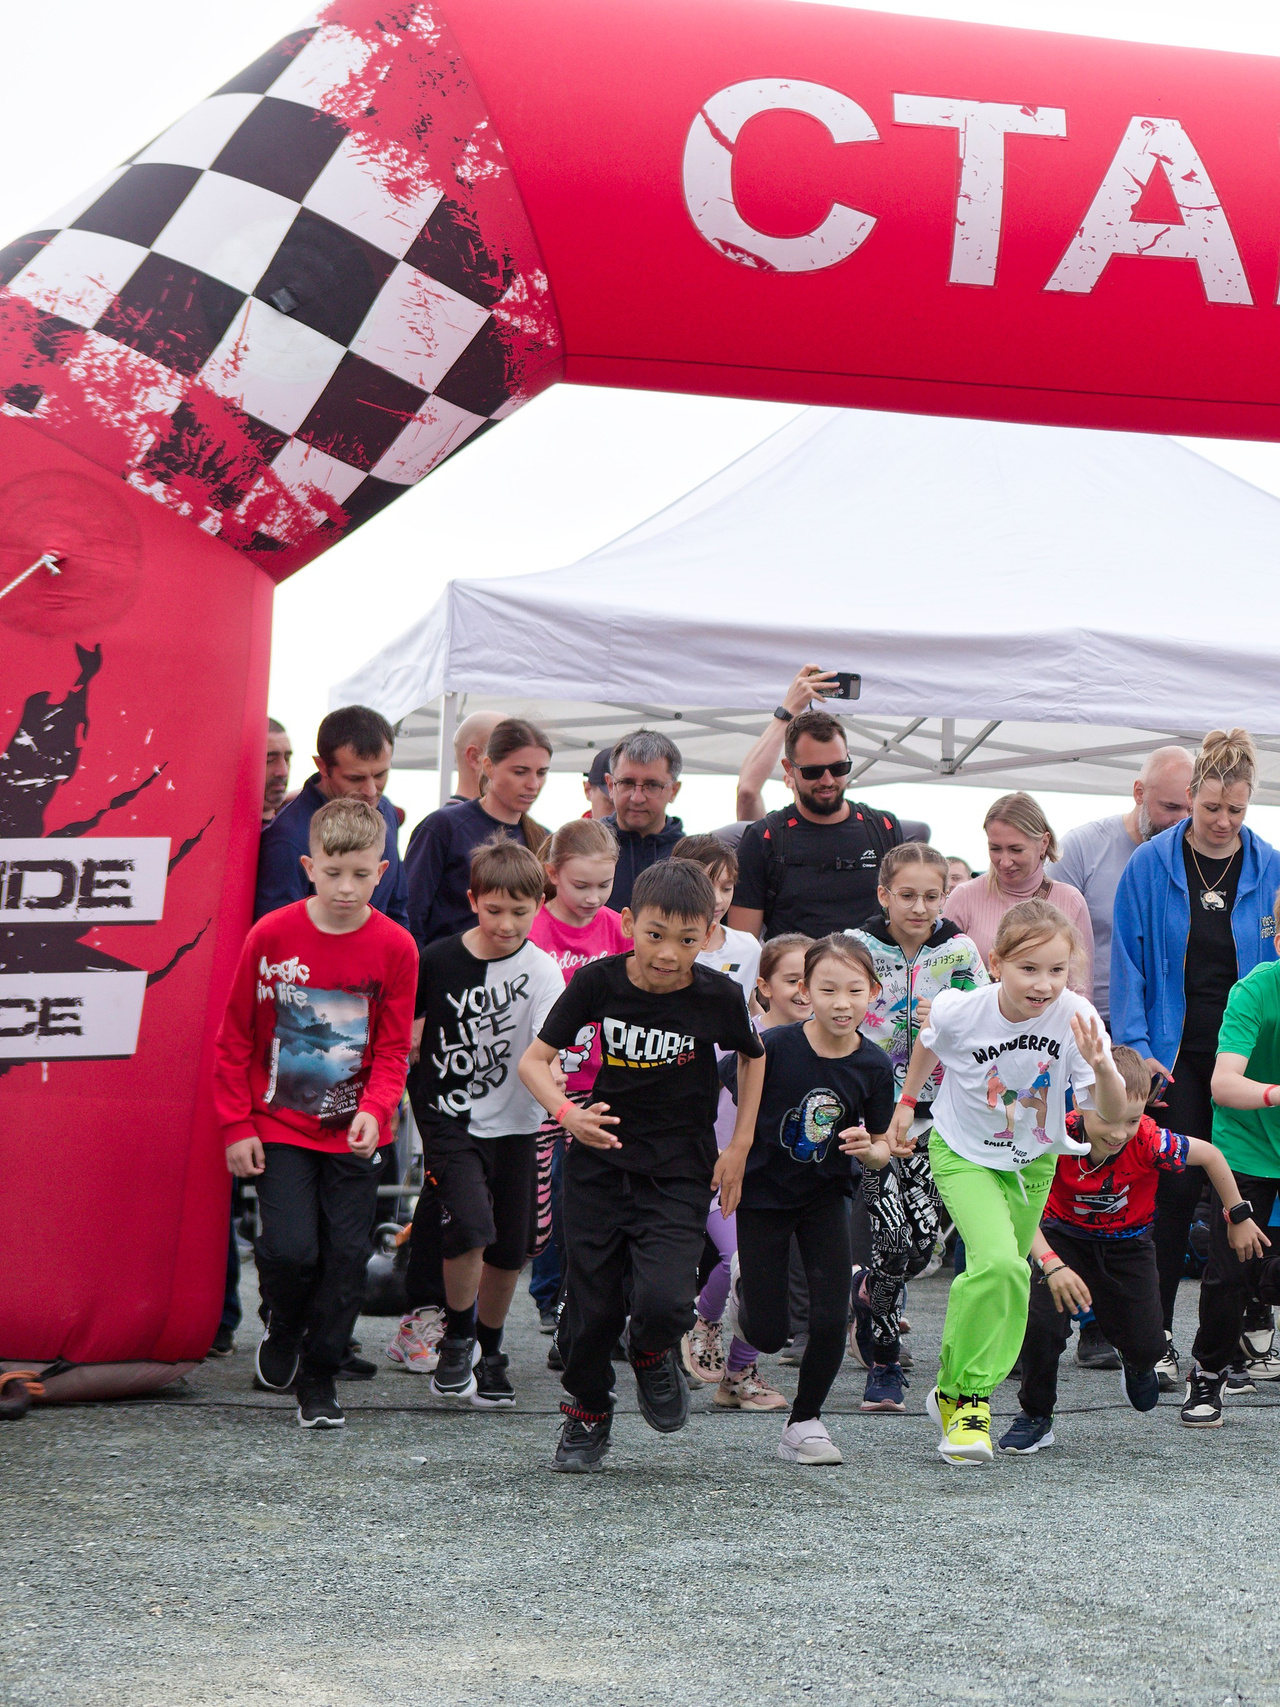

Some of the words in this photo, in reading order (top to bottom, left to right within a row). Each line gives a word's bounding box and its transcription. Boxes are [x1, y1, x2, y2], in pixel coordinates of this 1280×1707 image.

[278, 982, 308, 1009] life
[447, 973, 529, 1018] YOUR
[440, 1006, 517, 1052] LIFE
[432, 1040, 513, 1079] YOUR
